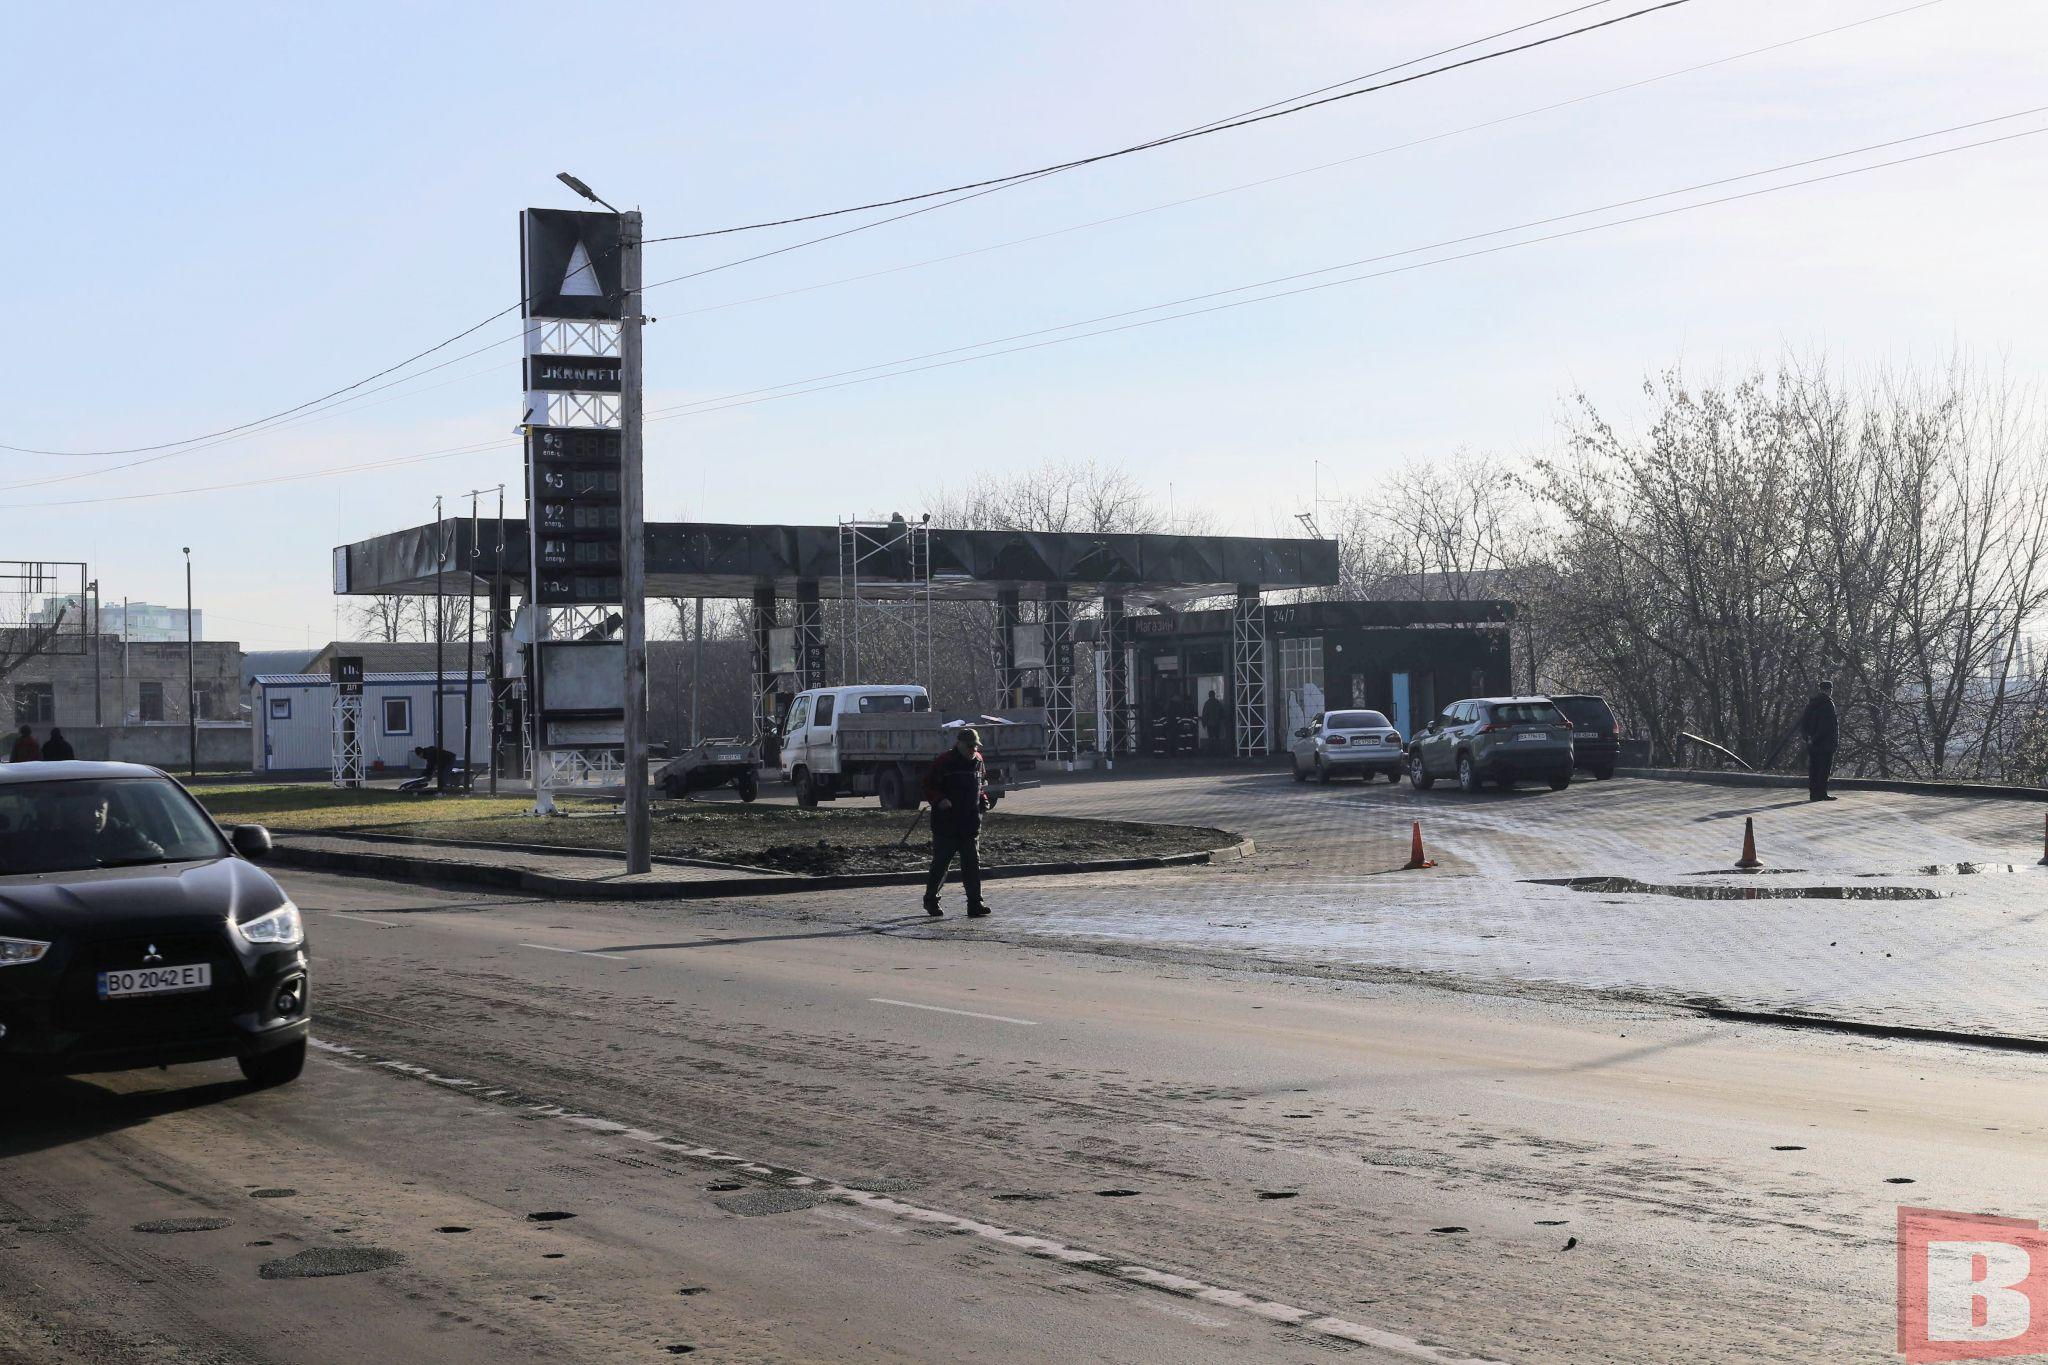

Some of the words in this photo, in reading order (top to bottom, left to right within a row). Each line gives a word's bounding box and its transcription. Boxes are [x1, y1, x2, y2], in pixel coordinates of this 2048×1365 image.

[545, 472, 564, 488] 95
[545, 504, 565, 519] 92
[1273, 608, 1295, 622] 24/7
[1135, 618, 1174, 633] Магазин
[108, 974, 135, 992] BO
[139, 969, 179, 989] 2042
[182, 966, 204, 985] EI
